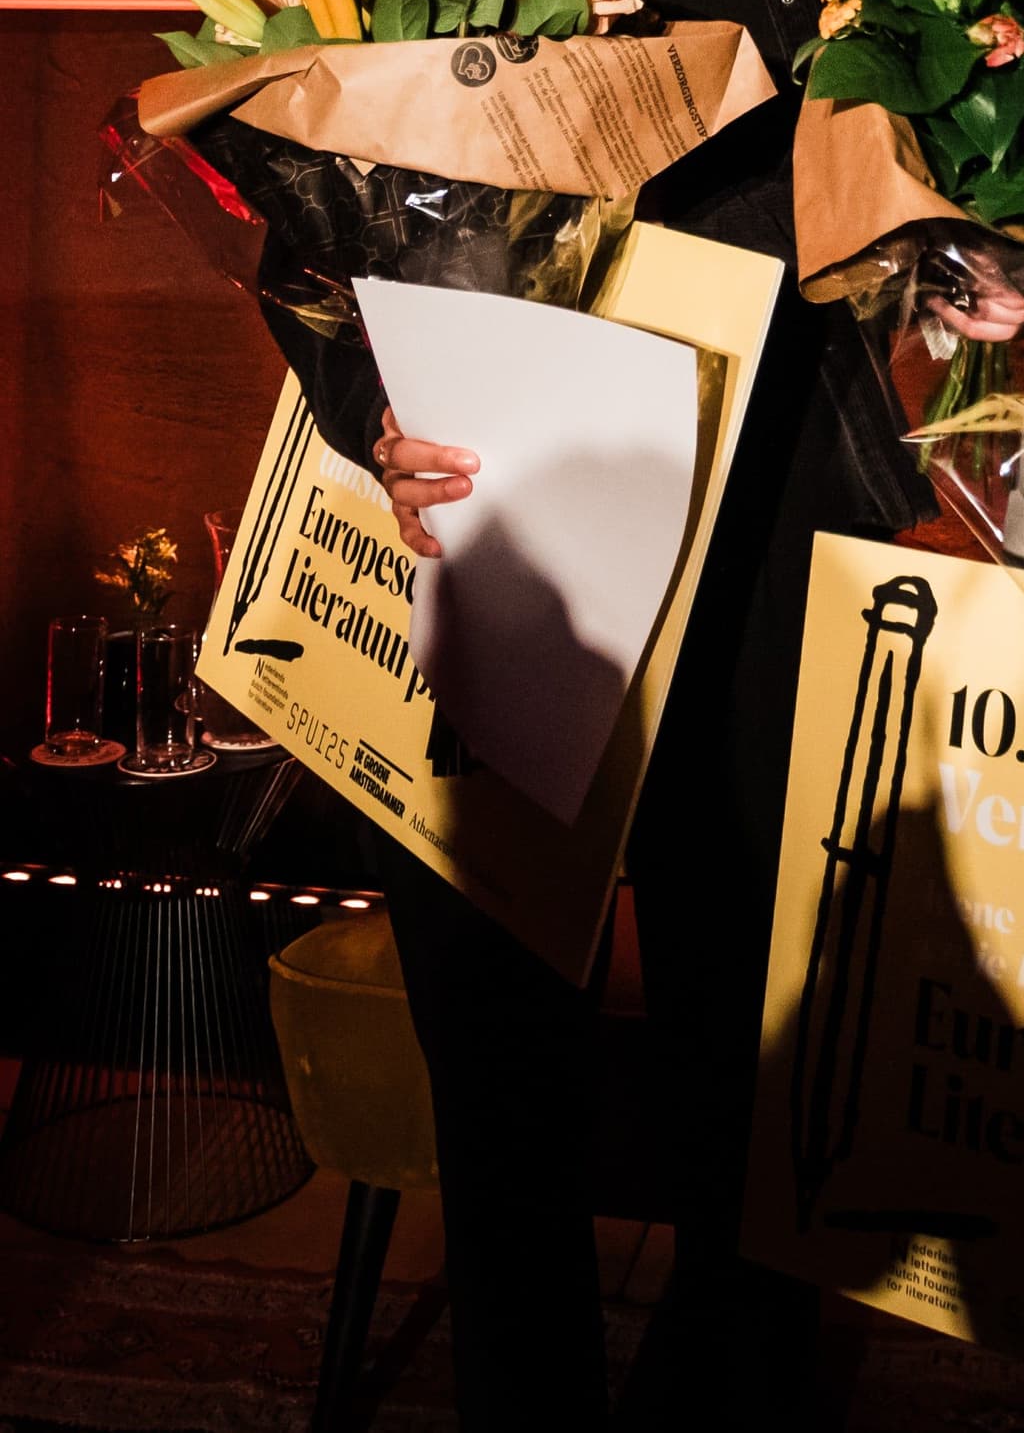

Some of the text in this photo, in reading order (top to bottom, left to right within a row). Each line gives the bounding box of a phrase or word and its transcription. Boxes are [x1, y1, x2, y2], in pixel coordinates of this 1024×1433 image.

[667, 43, 707, 139] VERZORGINGSTIP
[287, 702, 349, 769] SPUI25
[349, 766, 405, 820] AMSTERDAMMER
[354, 747, 390, 785] DE GROENE
[905, 1283, 959, 1313] literature
